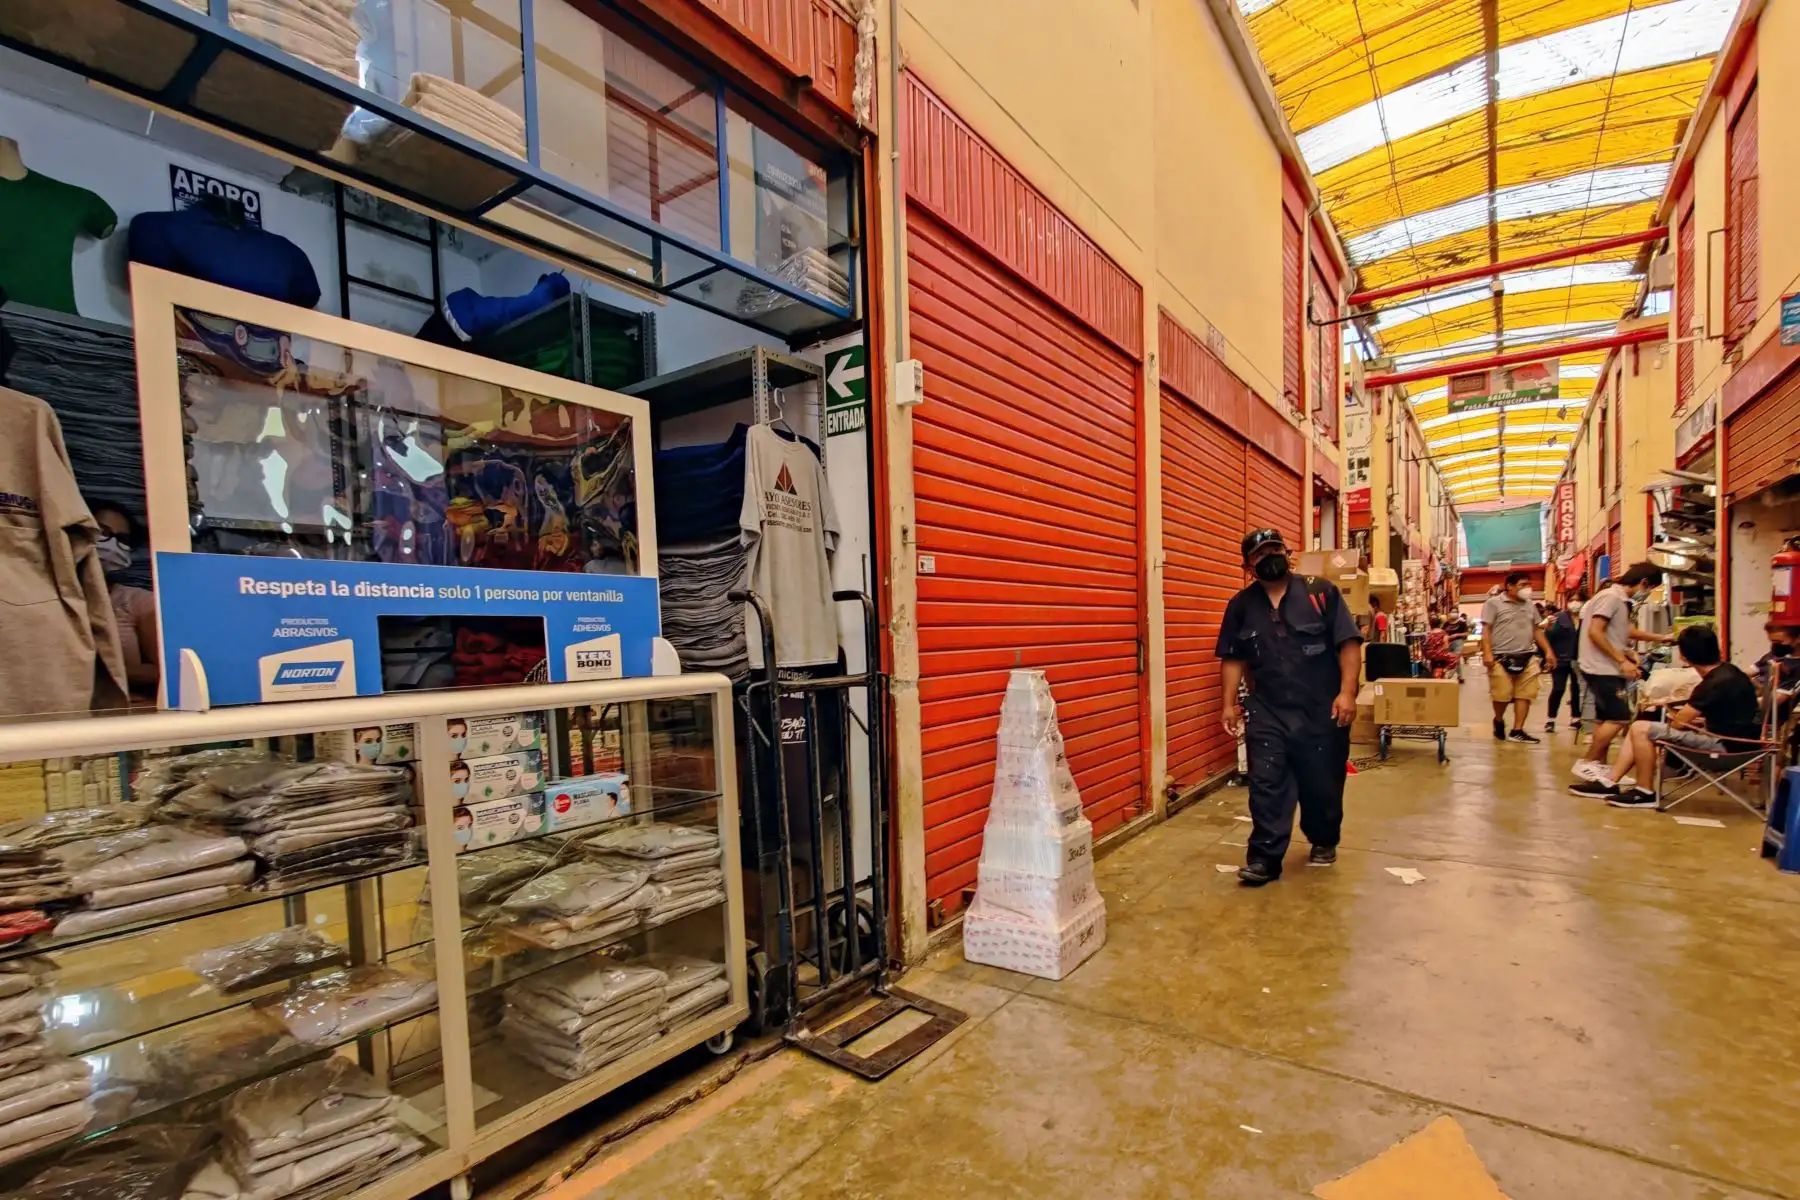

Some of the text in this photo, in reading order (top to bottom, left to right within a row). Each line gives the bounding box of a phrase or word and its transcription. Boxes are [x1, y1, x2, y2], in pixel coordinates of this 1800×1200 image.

[174, 168, 259, 213] AFORO
[827, 406, 865, 434] ENTRADA
[239, 577, 624, 603] Respeta la distancia solo 1 persona por ventanilla
[272, 627, 338, 638] ABRASIVOS
[572, 623, 612, 632] ADHESIVOS
[577, 651, 611, 660] TEK
[577, 659, 611, 668] BOND
[280, 667, 337, 679] NORTON
